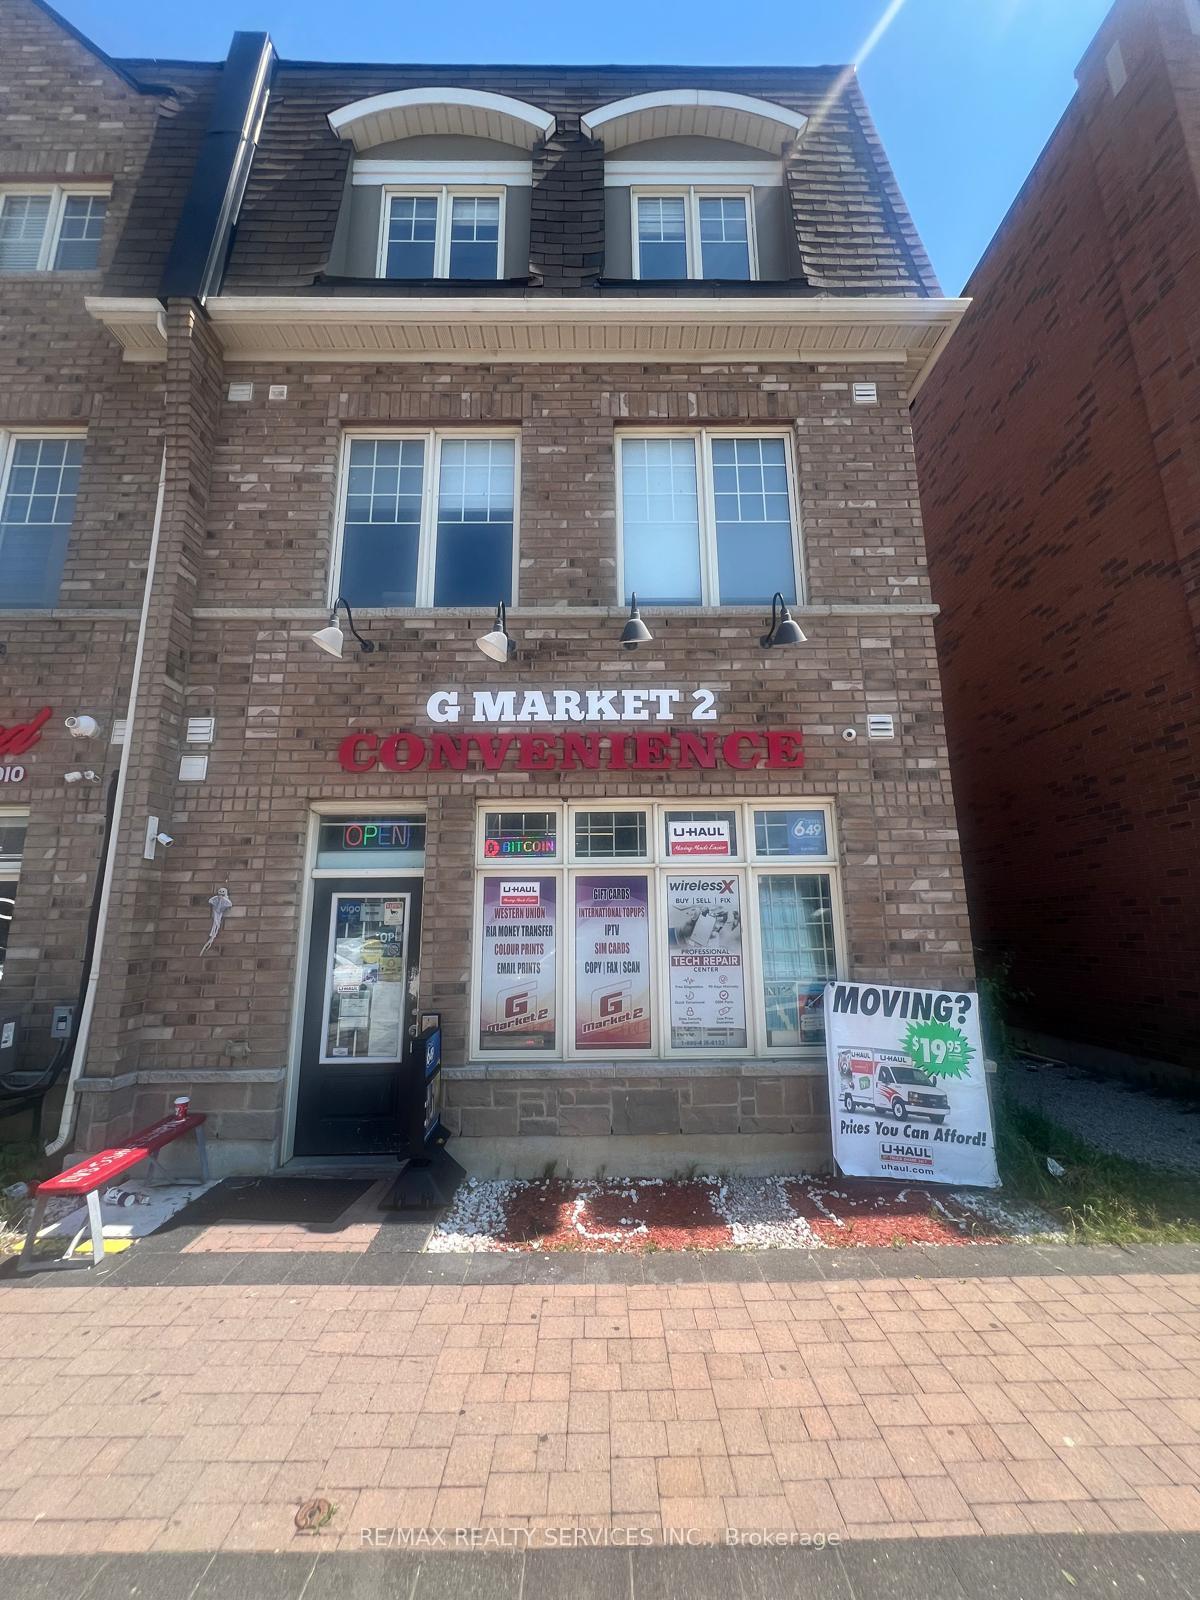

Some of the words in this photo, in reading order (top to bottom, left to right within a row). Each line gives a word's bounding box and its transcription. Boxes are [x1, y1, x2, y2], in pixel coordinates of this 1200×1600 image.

[426, 691, 461, 723] G
[472, 689, 681, 722] MARKET
[691, 689, 717, 720] 2
[338, 732, 805, 772] CONVENIENCE
[345, 823, 407, 848] OPEN
[673, 827, 725, 837] U-HAUL
[502, 840, 555, 853] BITCOIN
[673, 845, 692, 853] Moving
[670, 879, 735, 894] wirelessX
[593, 888, 608, 900] GIFT
[609, 888, 630, 900] CARDS
[340, 905, 361, 914] vigo
[494, 907, 524, 919] WESTERN
[525, 907, 546, 919] UNION
[579, 907, 621, 918] INTERNATIONAL
[622, 907, 645, 918] TOPUPS
[485, 925, 497, 937] RIA
[498, 925, 520, 937] MONEY
[521, 925, 553, 937] TRANSFER
[604, 924, 620, 936] IPTV
[494, 943, 520, 956] COLOUR
[521, 943, 544, 955] PRINTS
[594, 943, 608, 954] SIM
[608, 942, 630, 954] CARDS
[584, 961, 602, 974] COPY
[606, 961, 618, 974] FAX
[622, 960, 641, 973] SCAN
[673, 956, 700, 966] TECH
[702, 956, 738, 966] REPAIR
[497, 962, 516, 975] EMAIL
[517, 962, 541, 974] PRINTS
[505, 992, 529, 1018] G
[600, 992, 623, 1017] G
[833, 985, 972, 1025] MOVING?
[880, 1055, 907, 1063] U-HAUL
[840, 1119, 870, 1135] Prices
[875, 1121, 899, 1136] You
[903, 1124, 929, 1140] Can
[933, 1127, 987, 1147] Afford!
[881, 1144, 931, 1158] U-HAUL
[881, 1163, 934, 1176] uhaul.com
